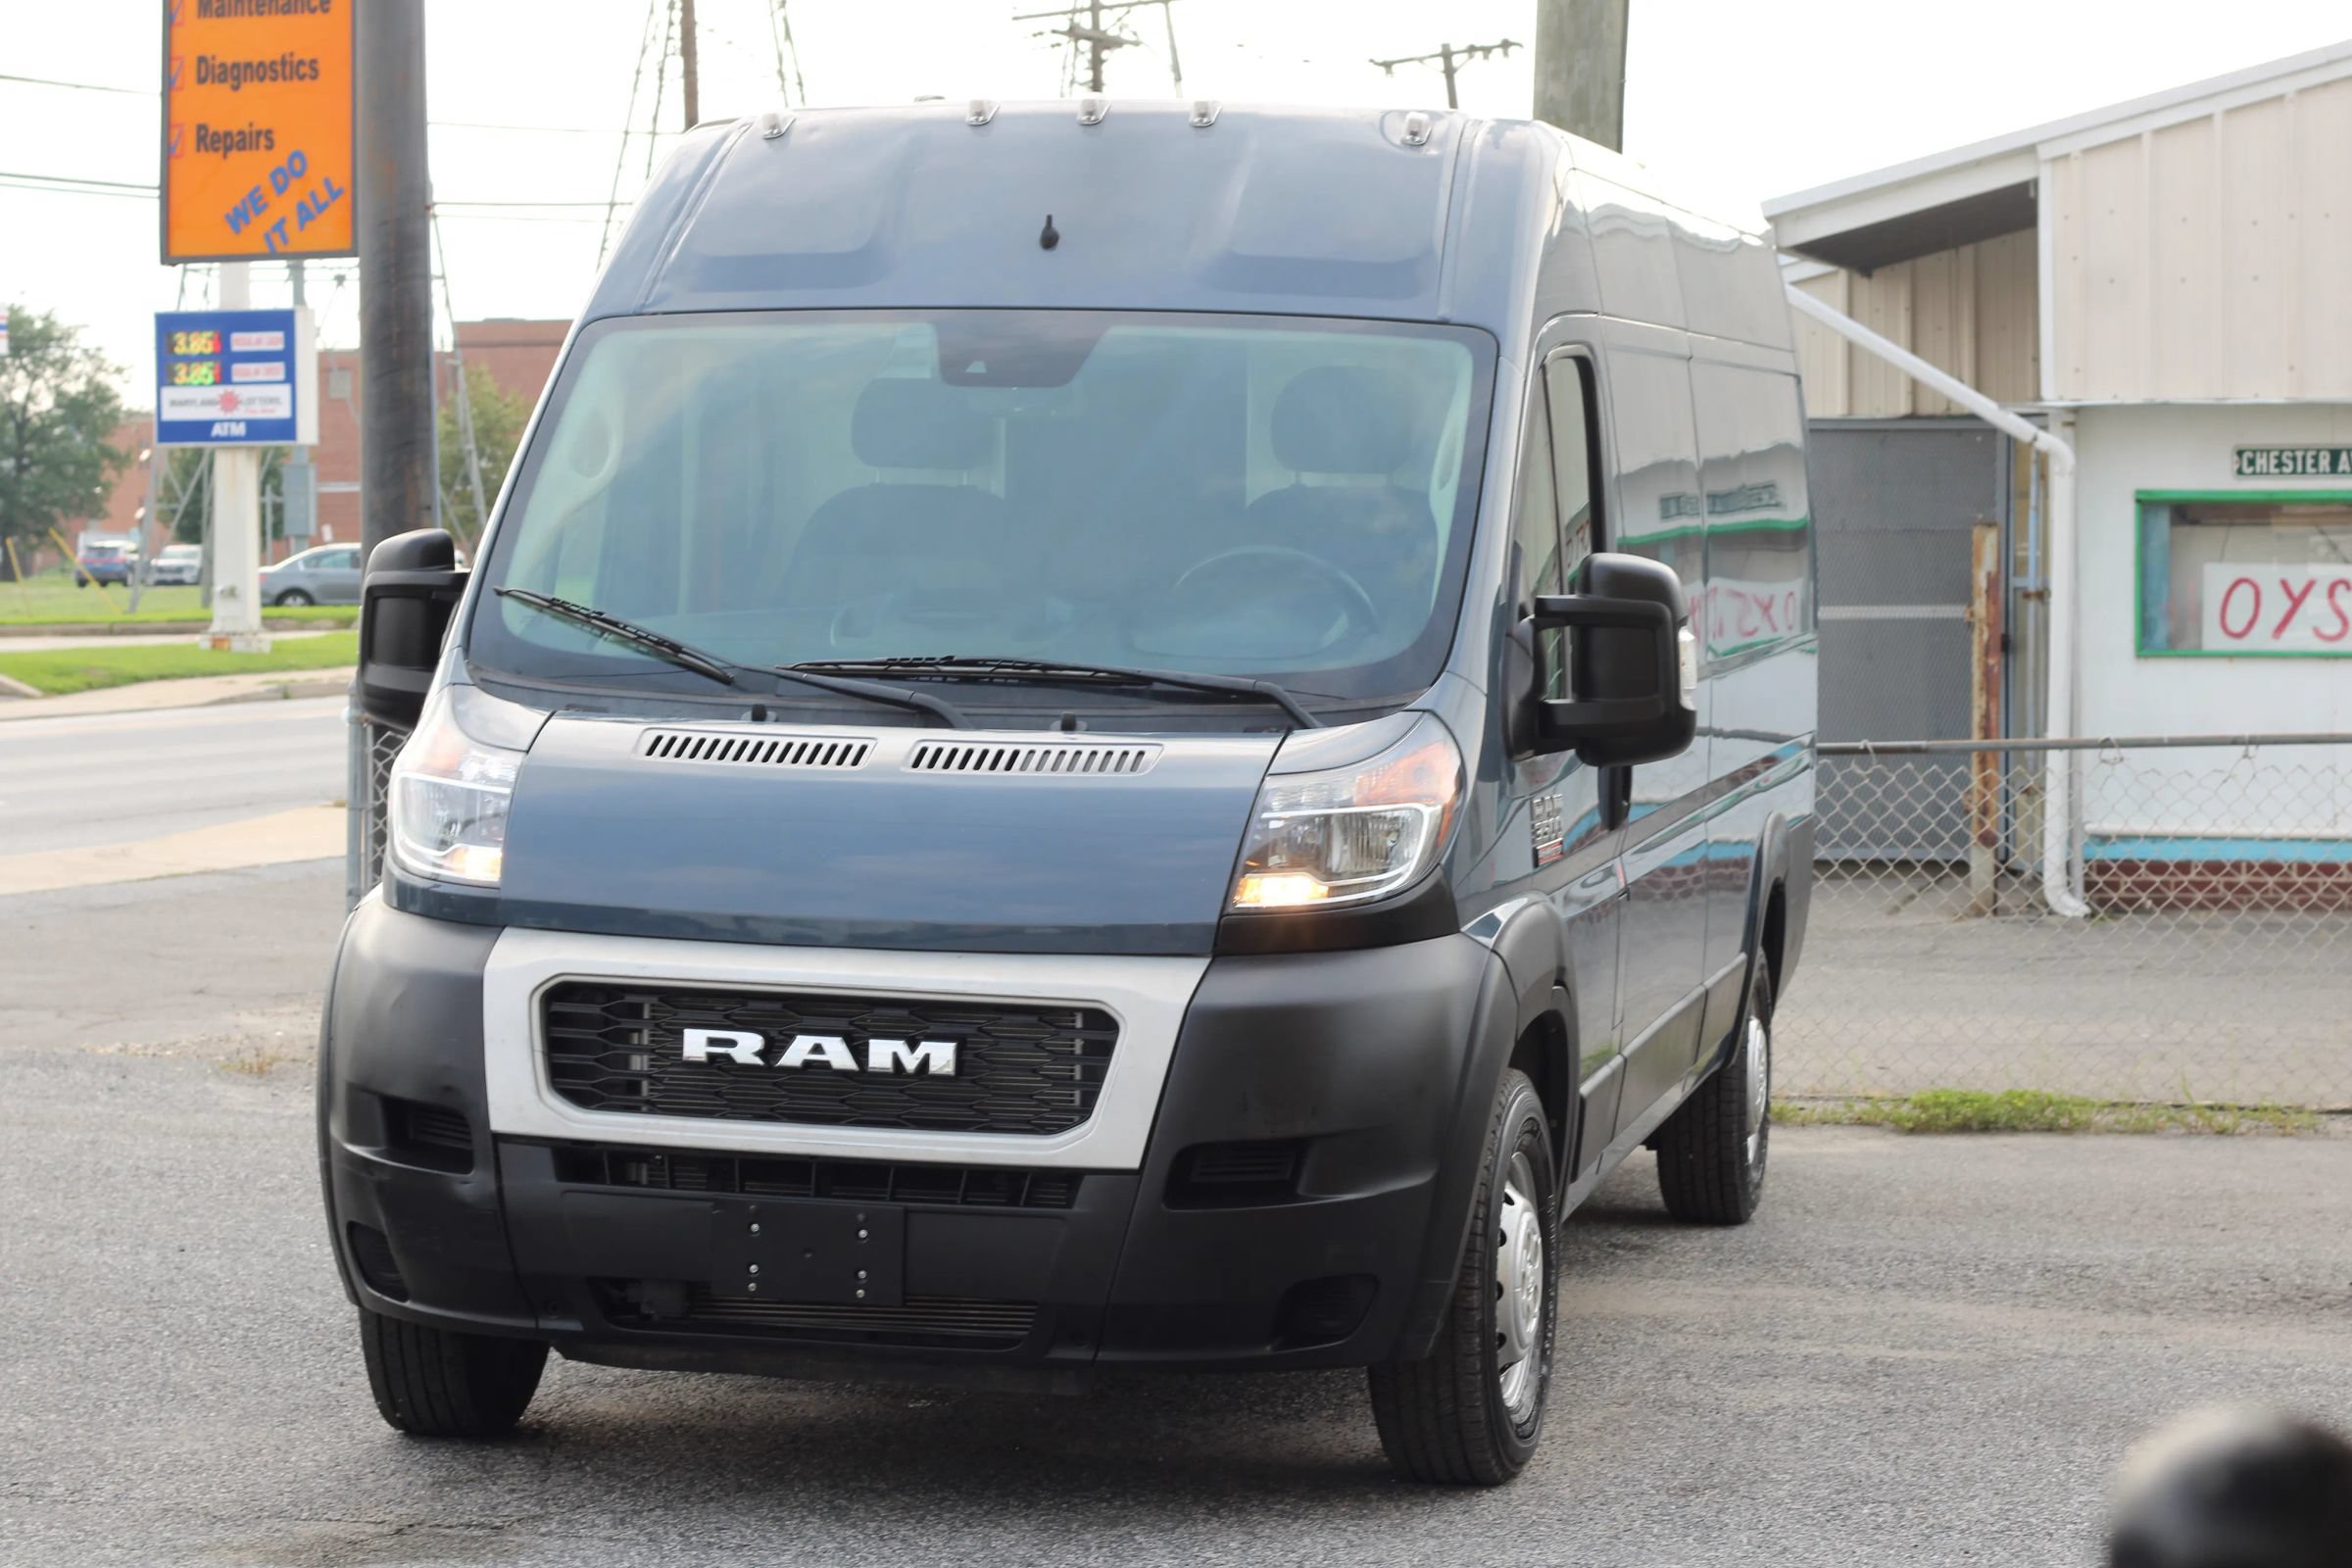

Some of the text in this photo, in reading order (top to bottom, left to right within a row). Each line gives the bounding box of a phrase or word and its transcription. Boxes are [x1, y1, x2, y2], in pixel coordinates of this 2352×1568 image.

[196, 52, 319, 91] Diagnostics
[195, 122, 274, 160] Repairs
[223, 150, 308, 235] WE DO
[263, 176, 344, 255] IT ALL
[210, 421, 246, 437] ATM
[2241, 451, 2352, 474] CHESTER A
[2219, 576, 2352, 643] OYS
[682, 1028, 957, 1076] RAM
